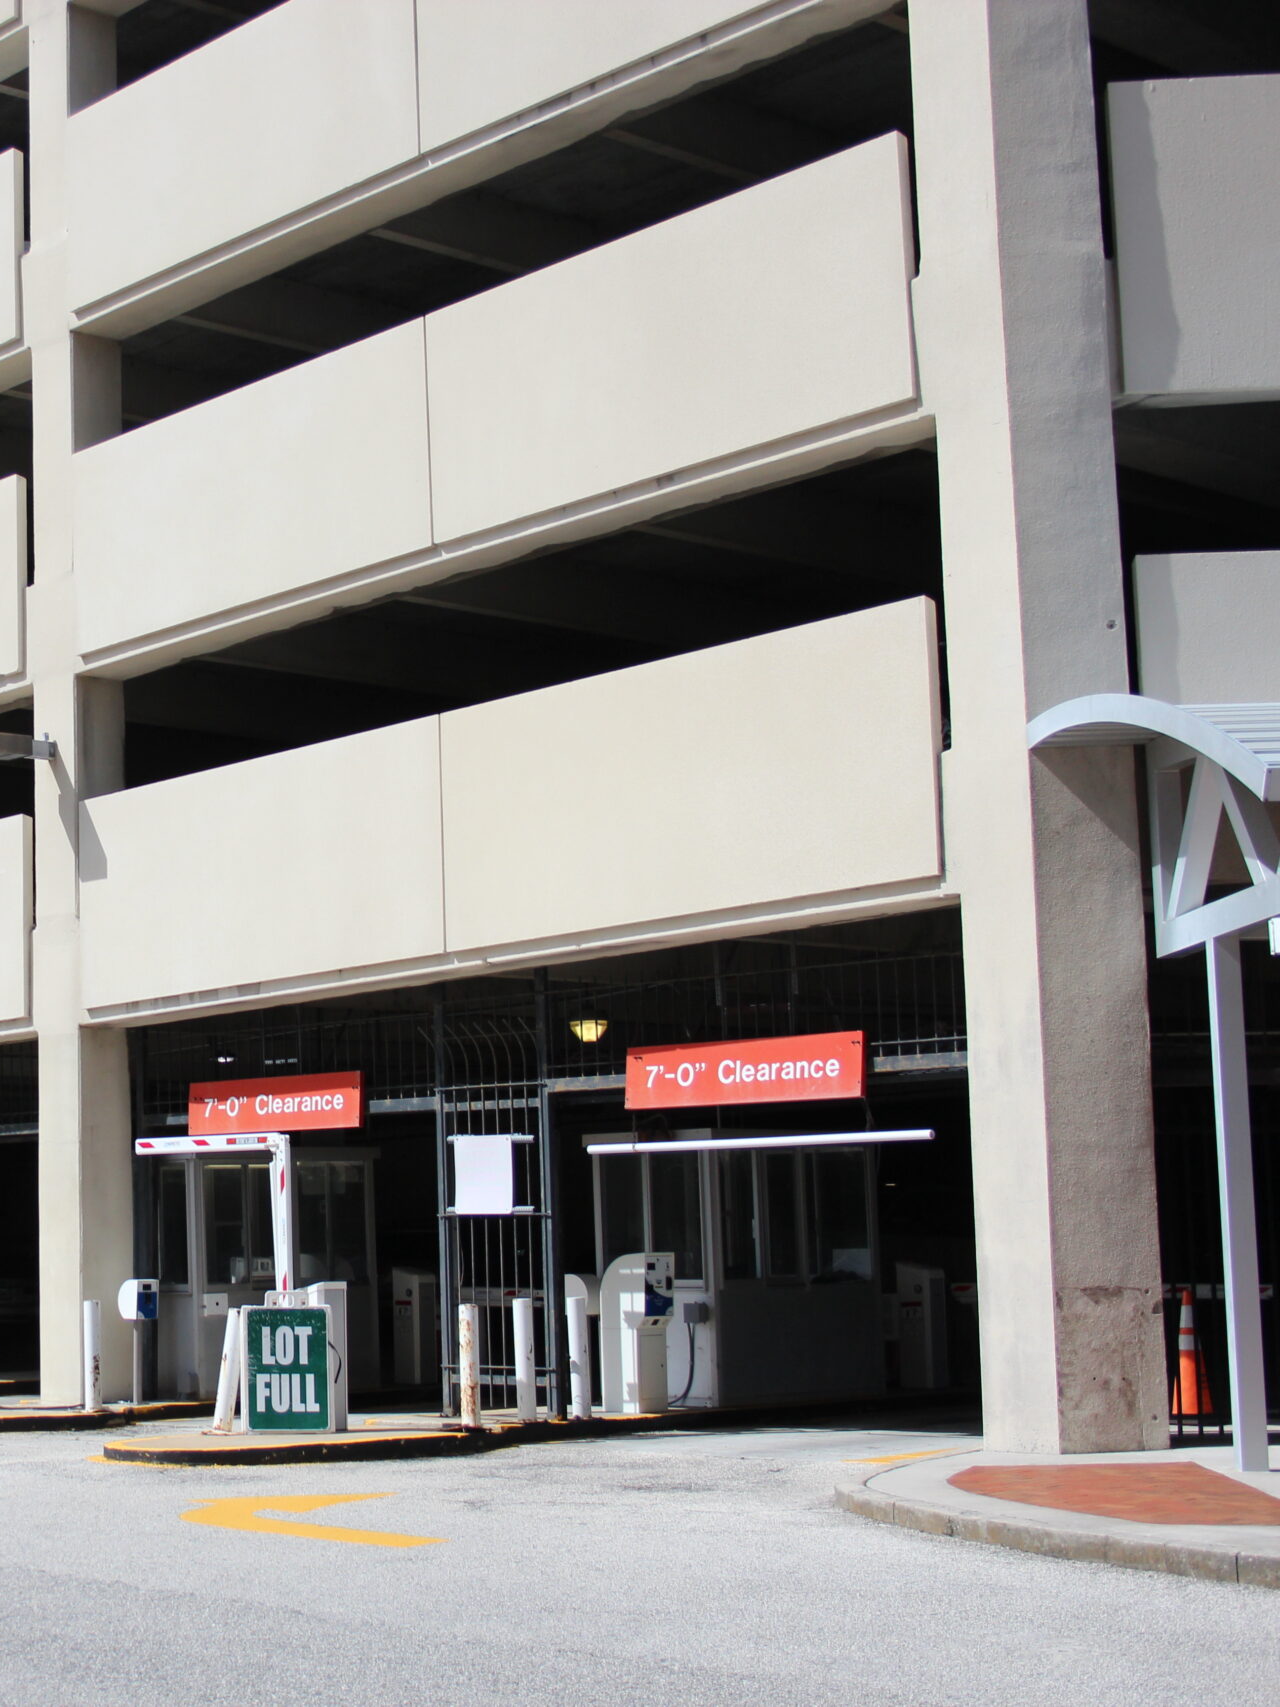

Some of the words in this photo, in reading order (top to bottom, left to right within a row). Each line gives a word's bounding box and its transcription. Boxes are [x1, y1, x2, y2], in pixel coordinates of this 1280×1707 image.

[717, 1058, 840, 1084] Clearance
[255, 1094, 344, 1115] Clearance
[261, 1325, 313, 1366] LOT
[256, 1373, 320, 1413] FULL
